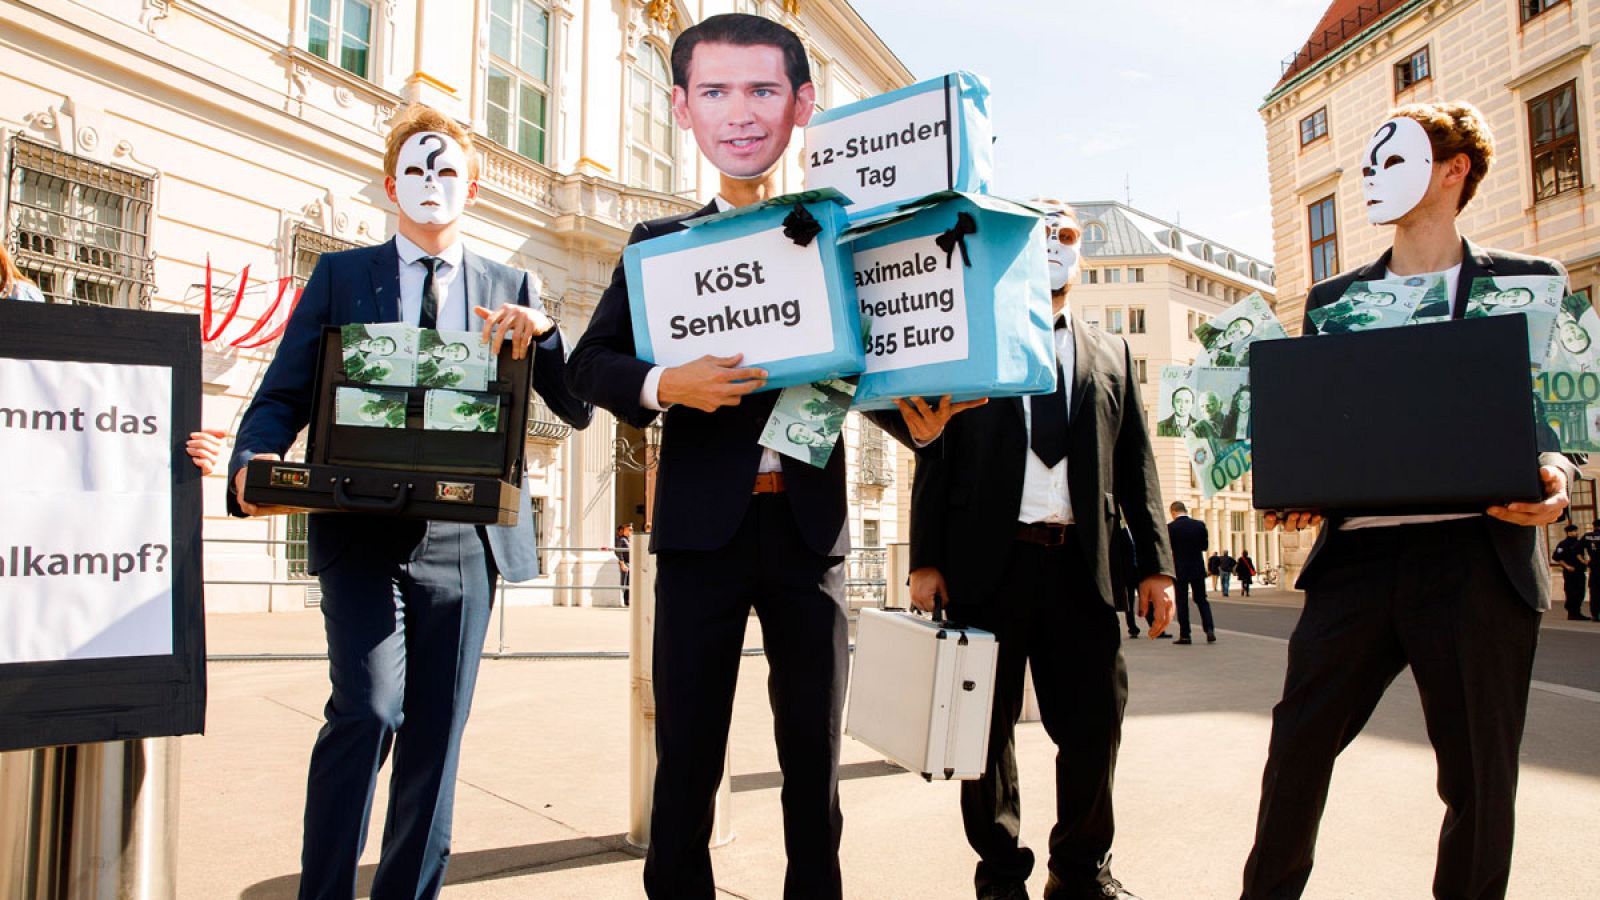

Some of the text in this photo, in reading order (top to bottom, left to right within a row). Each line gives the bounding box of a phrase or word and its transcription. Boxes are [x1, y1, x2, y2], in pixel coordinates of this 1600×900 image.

[419, 134, 448, 182] ?
[811, 119, 947, 168] 12-Stunden
[856, 165, 897, 188] Tag
[694, 260, 766, 296] KöSt
[670, 299, 801, 340] Senkung
[903, 325, 955, 349] Euro
[1537, 371, 1600, 401] 100
[95, 405, 158, 435] das
[0, 543, 169, 582] lkampf?
